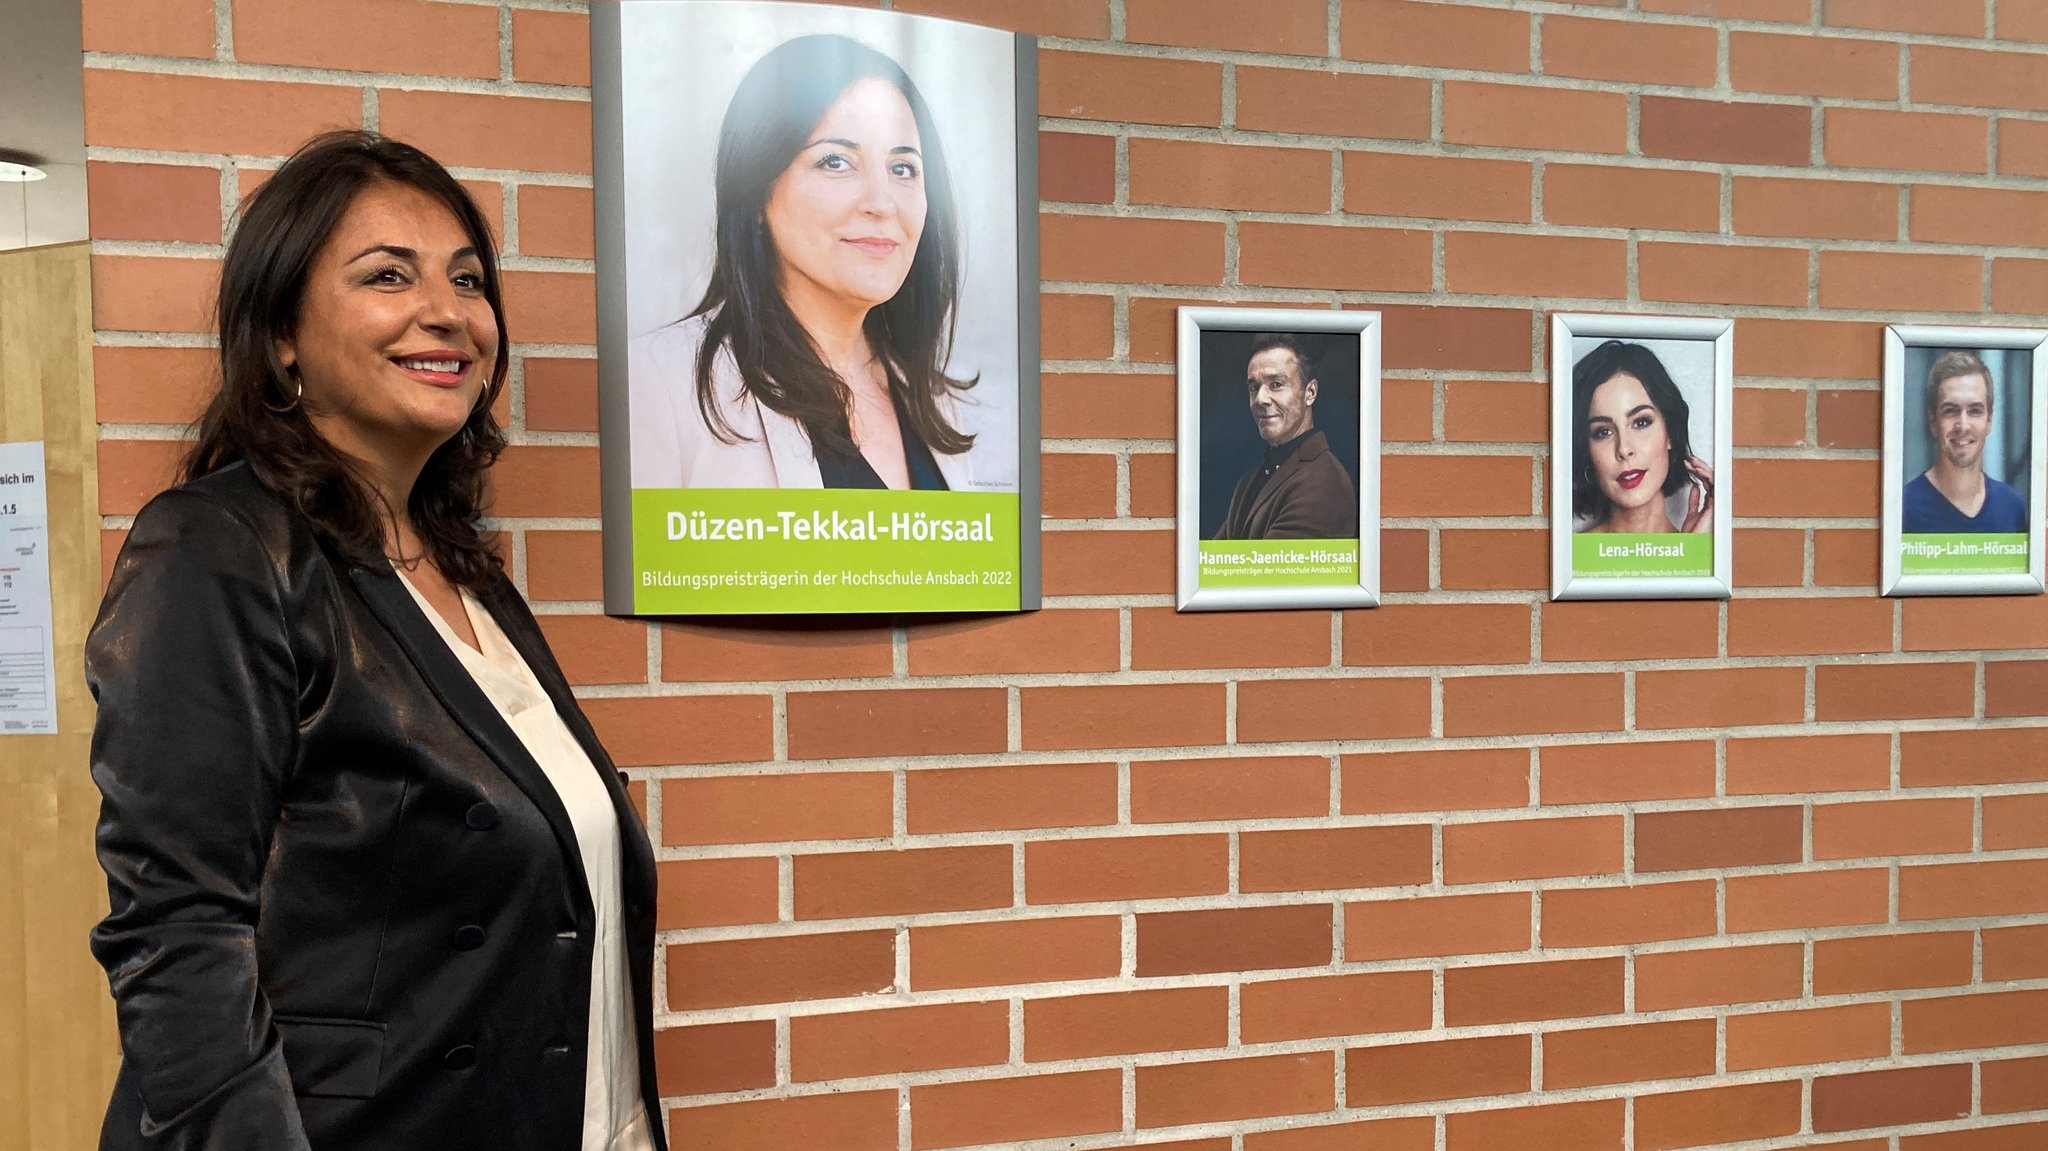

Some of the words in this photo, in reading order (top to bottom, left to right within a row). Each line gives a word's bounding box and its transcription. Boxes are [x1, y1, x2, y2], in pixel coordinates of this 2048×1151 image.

[0, 473, 20, 485] sich
[22, 473, 35, 484] im
[666, 510, 994, 542] Düzen-Tekkal-Hörsaal
[1199, 549, 1358, 565] Hannes-Jaenicke-Hörsaal
[1599, 542, 1685, 557] Lena-Hörsaal
[1901, 541, 2028, 558] Philipp-Lahm-Hörsaal
[1203, 567, 1263, 576] Bildungspreisträger
[1264, 566, 1274, 574] der
[1275, 566, 1309, 575] Hochschule
[1310, 565, 1336, 574] Ansbach
[1337, 565, 1352, 573] 2021
[642, 570, 808, 590] Bildungspreisträgerin
[813, 570, 837, 586] der
[842, 569, 922, 586] Hochschule
[926, 570, 979, 585] Ansbach
[982, 571, 1012, 585] 2022
